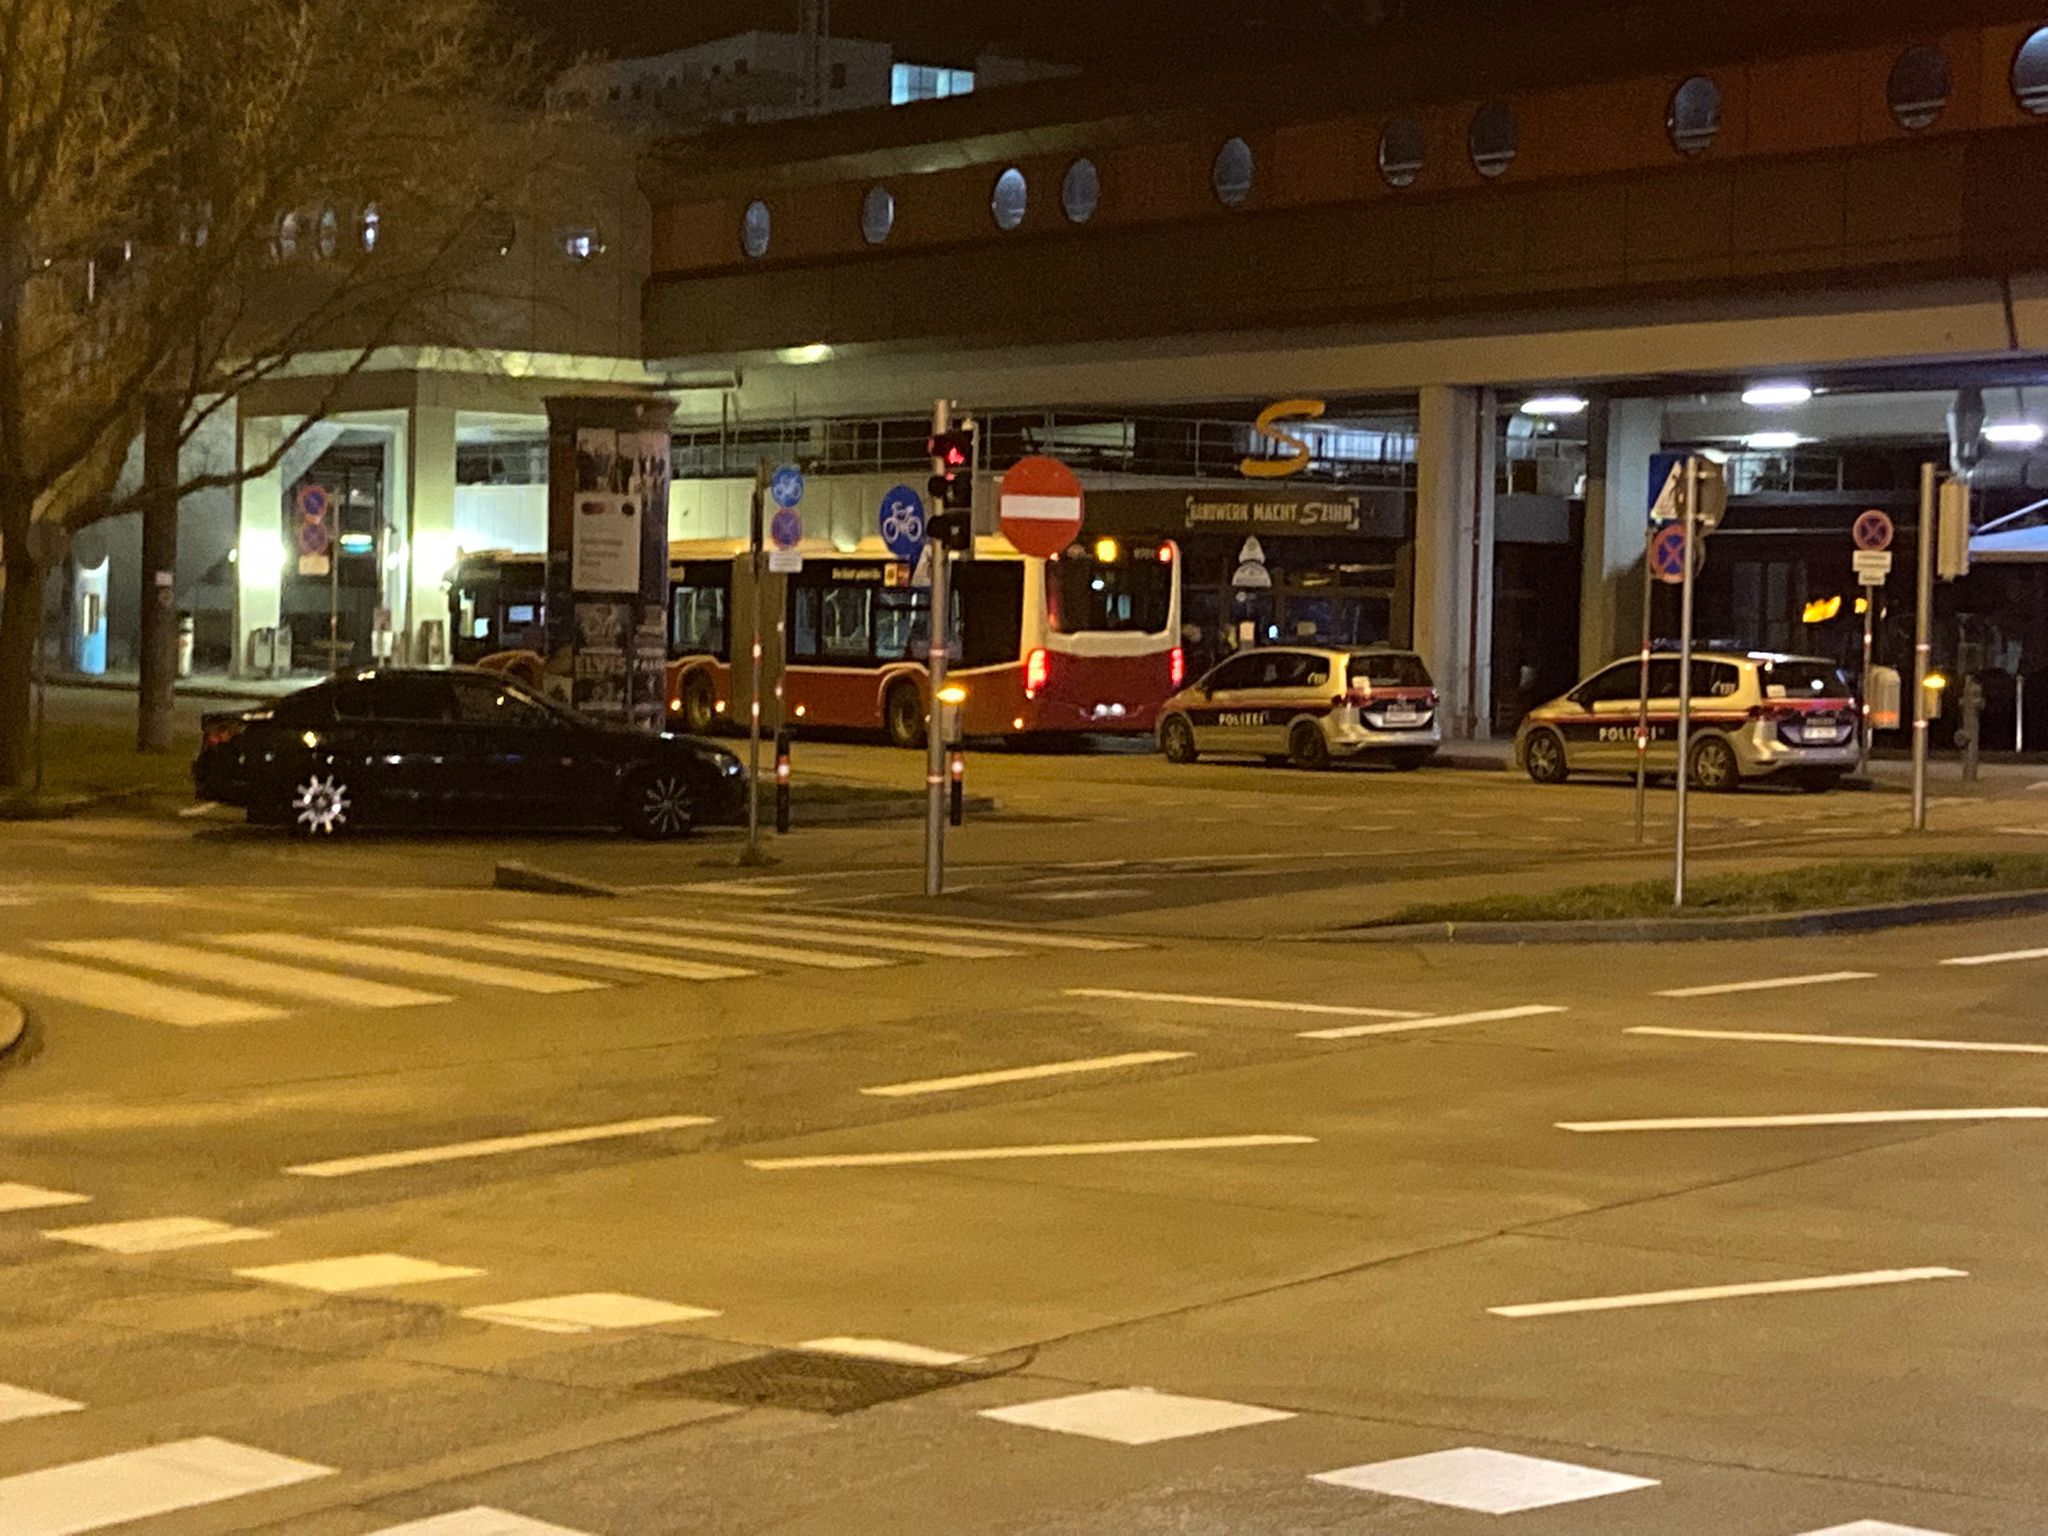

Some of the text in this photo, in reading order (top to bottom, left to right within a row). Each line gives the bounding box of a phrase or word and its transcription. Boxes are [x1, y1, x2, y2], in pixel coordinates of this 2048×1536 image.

[1240, 400, 1326, 478] S
[1253, 503, 1297, 522] MACHT
[1219, 712, 1264, 728] POLIZEI
